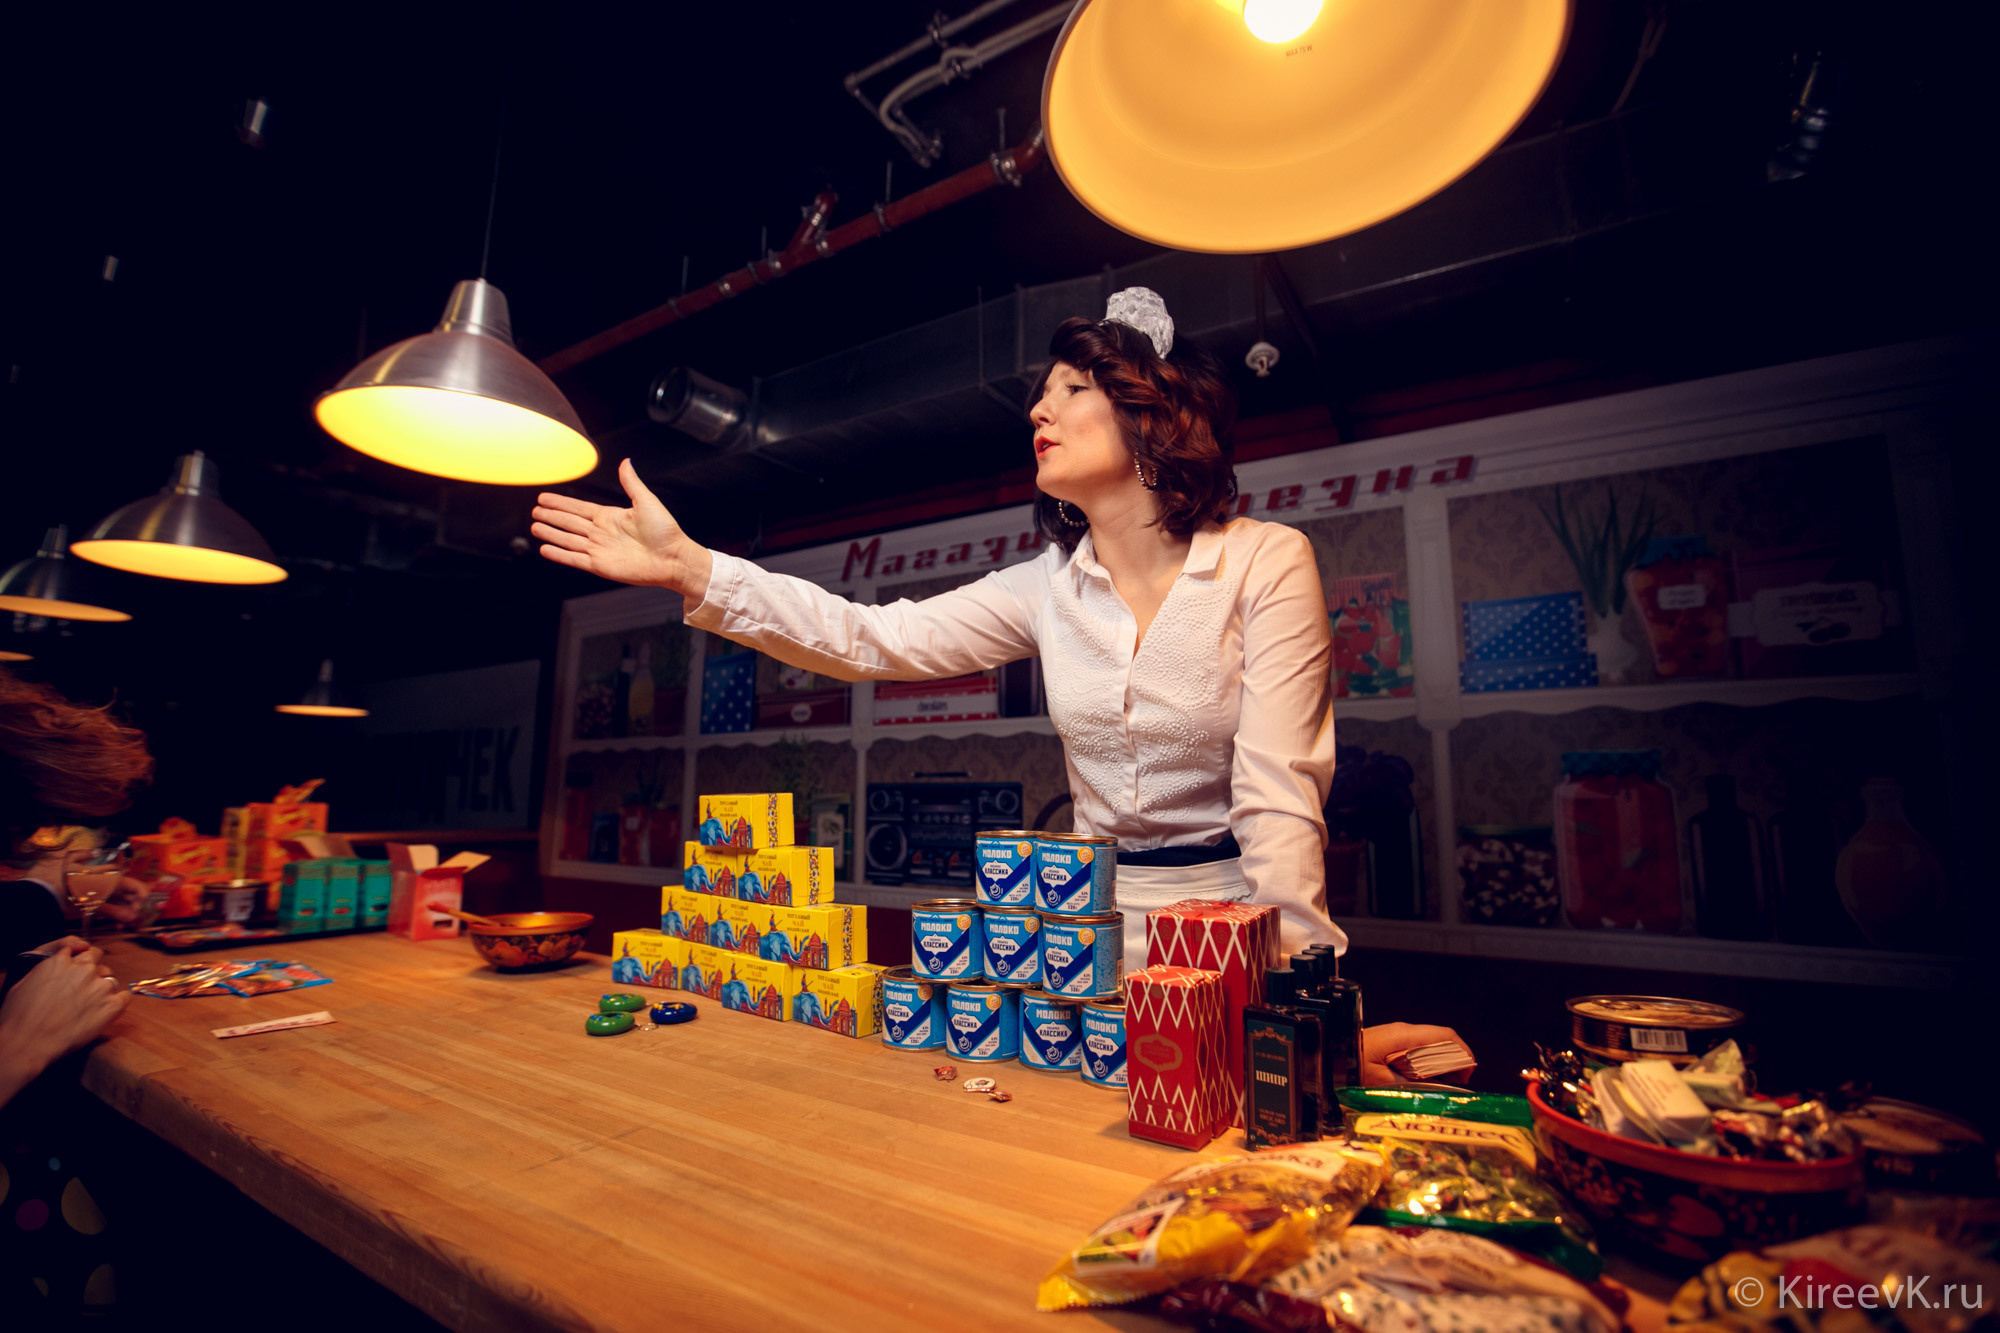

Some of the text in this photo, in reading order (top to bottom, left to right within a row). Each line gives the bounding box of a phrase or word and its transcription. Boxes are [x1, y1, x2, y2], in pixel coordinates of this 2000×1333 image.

[841, 531, 1046, 582] Магази
[982, 849, 1012, 859] МОЛОКО
[1041, 852, 1072, 864] МОЛОКО
[985, 868, 1008, 876] КЛАССИКА
[1043, 872, 1067, 882] КЛАССИКА
[920, 922, 952, 932] МОЛОКО
[989, 924, 1019, 935] МОЛОКО
[923, 940, 949, 949] КЛАССИКА
[1045, 932, 1073, 946] МОЛОКО
[991, 942, 1016, 952] КЛАССИКА
[1047, 953, 1069, 964] КЛАССИКА
[886, 989, 912, 1002] МОЛОКО
[951, 1000, 981, 1012] МОЛОКО
[888, 1009, 909, 1018] КЛАССИКА
[1036, 1009, 1071, 1020] МОЛОКО
[953, 1019, 977, 1029] КЛАССИКА
[1085, 1018, 1117, 1034] МОЛОКО
[1039, 1028, 1068, 1038] КЛАССИКА
[1088, 1040, 1114, 1052] КЛАССИКА
[1255, 1069, 1288, 1087] ШИПР
